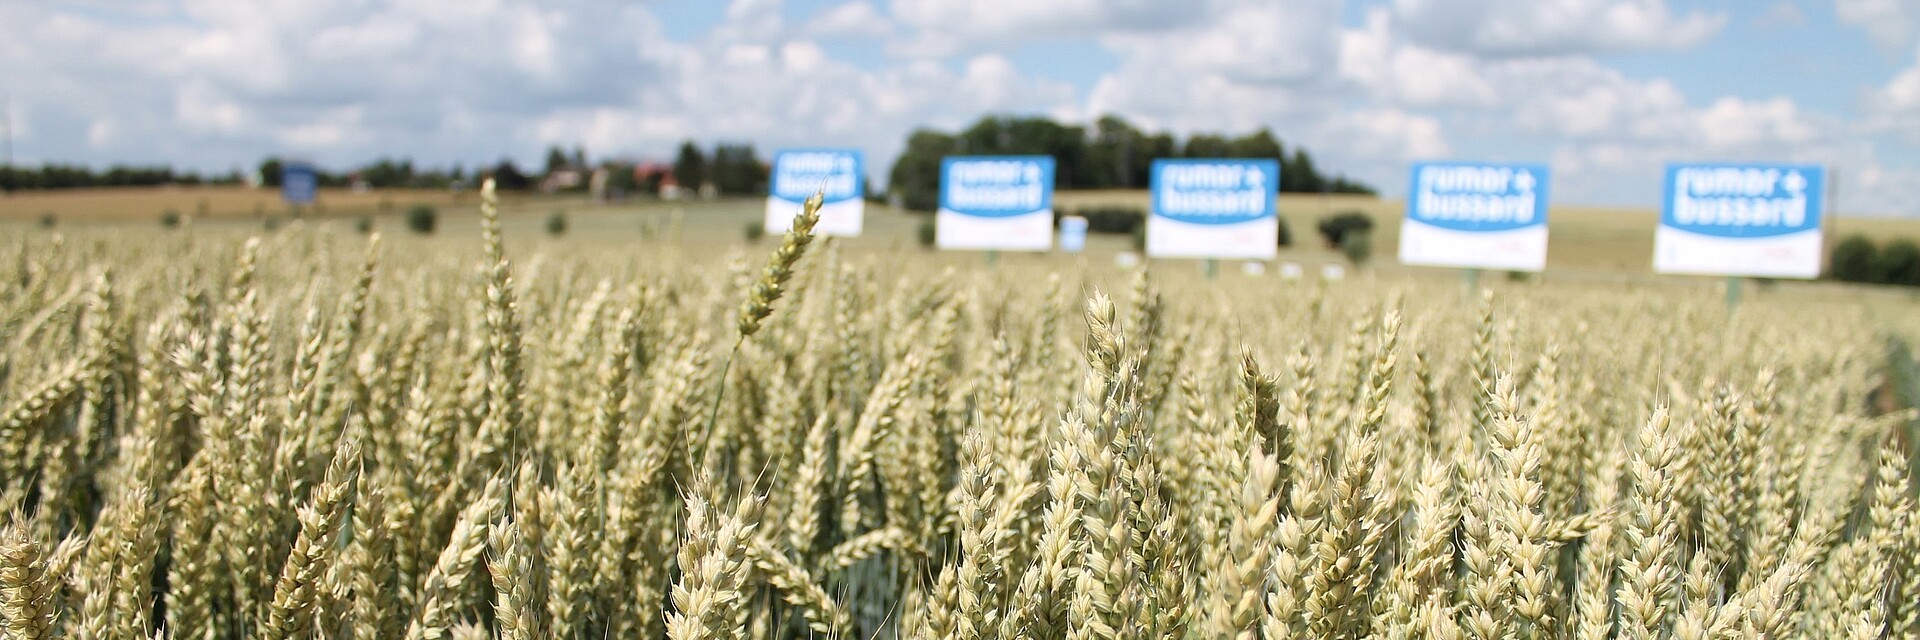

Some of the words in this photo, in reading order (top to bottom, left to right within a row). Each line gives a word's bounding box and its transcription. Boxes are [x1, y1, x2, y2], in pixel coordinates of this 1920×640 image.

[1676, 167, 1780, 197] rumor
[1417, 189, 1535, 224] bussard
[1674, 190, 1806, 227] bussard
